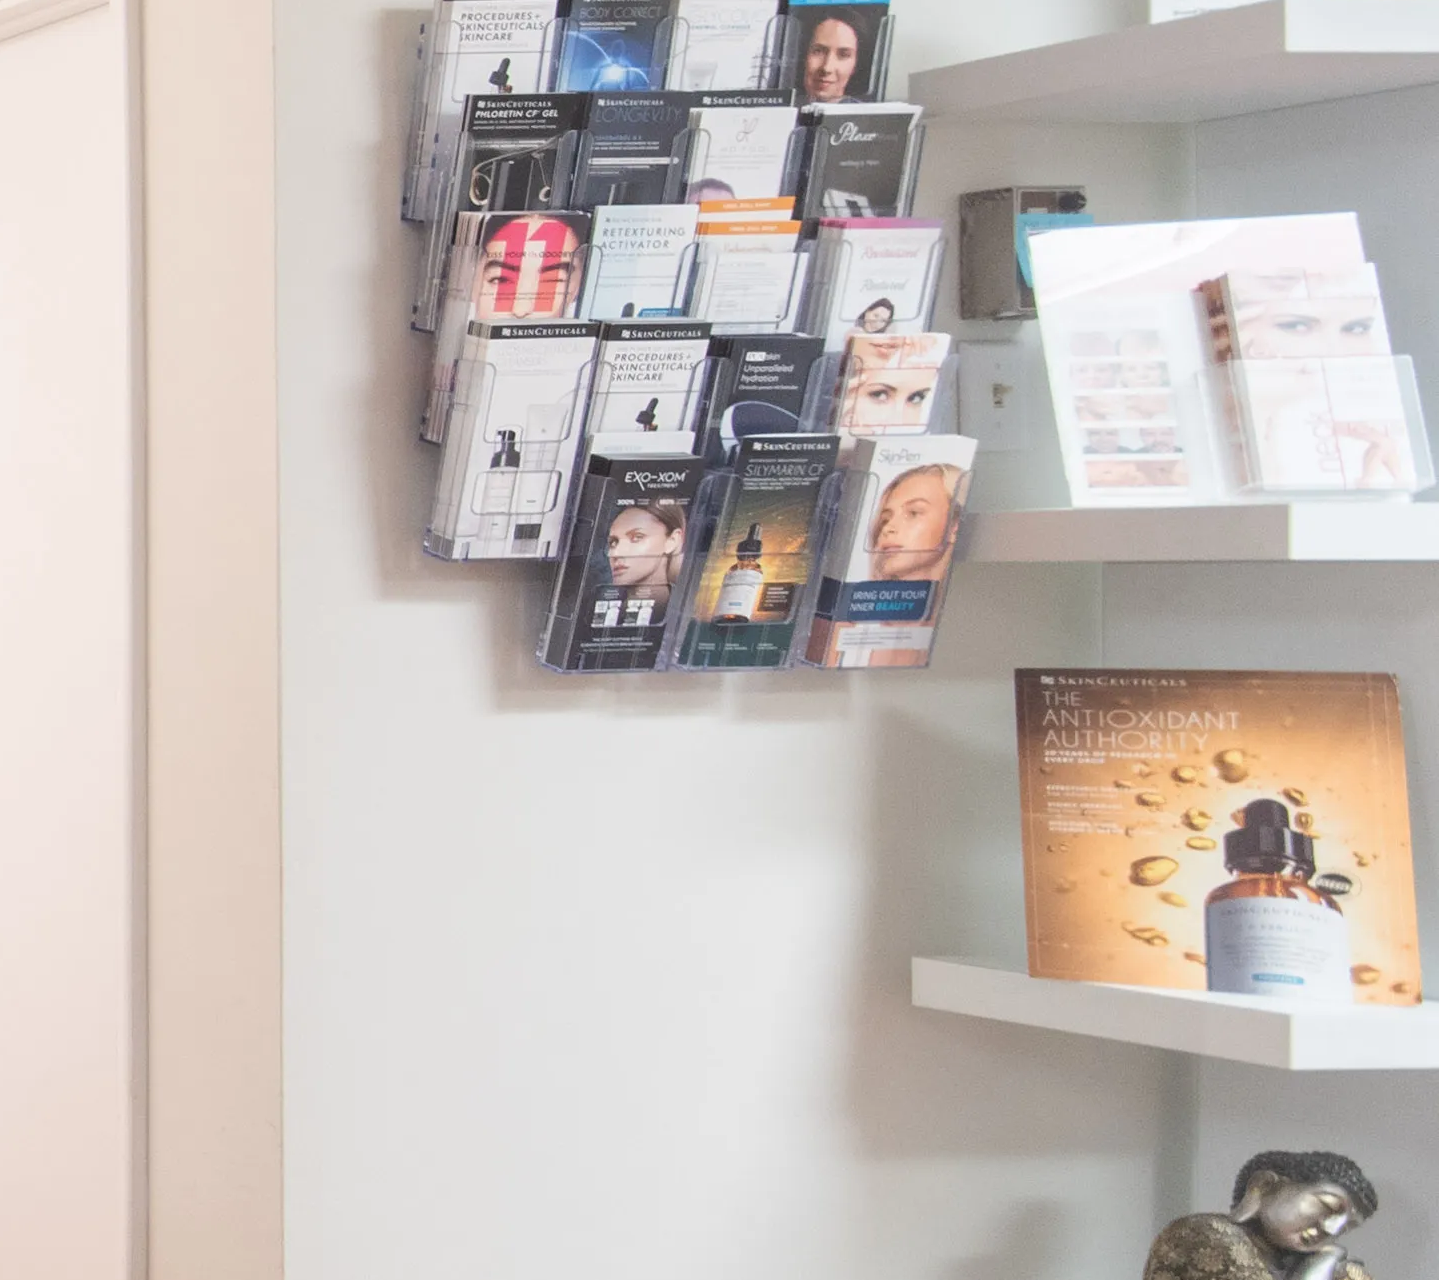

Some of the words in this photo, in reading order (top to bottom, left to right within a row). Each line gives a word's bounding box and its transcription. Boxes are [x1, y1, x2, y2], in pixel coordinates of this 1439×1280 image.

[461, 12, 533, 21] PROCEDURES
[460, 22, 544, 32] SKINCEUTICALS
[460, 33, 513, 41] SKINCARE
[487, 100, 552, 108] SKINCEUTICALS
[606, 98, 664, 106] SKINCEUTICALS
[712, 96, 783, 105] SKINCEUTICALS
[475, 110, 524, 119] PHLORETIN
[542, 109, 559, 118] GEL
[602, 227, 686, 237] RETEXTURING
[601, 240, 670, 250] ACTIVATOR
[512, 327, 587, 337] SKINCEUTICALS
[631, 329, 702, 339] SKINCEUTICALS
[614, 353, 684, 362] PROCEDURES
[611, 362, 695, 372] SKINCEUTICALS
[610, 372, 663, 382] SKINCARE
[740, 374, 780, 384] hydration
[763, 442, 831, 451] SKINCEUTICALS
[624, 471, 686, 491] EXO-XOM
[879, 590, 899, 600] OUT
[901, 590, 927, 600] YOUR
[875, 602, 915, 611] BEAUTY
[1059, 676, 1187, 687] SKINCEUTICALS
[1043, 690, 1082, 706] THE
[1043, 709, 1241, 730] ANTIOXIDANT
[1044, 730, 1210, 750] AUTHORITY
